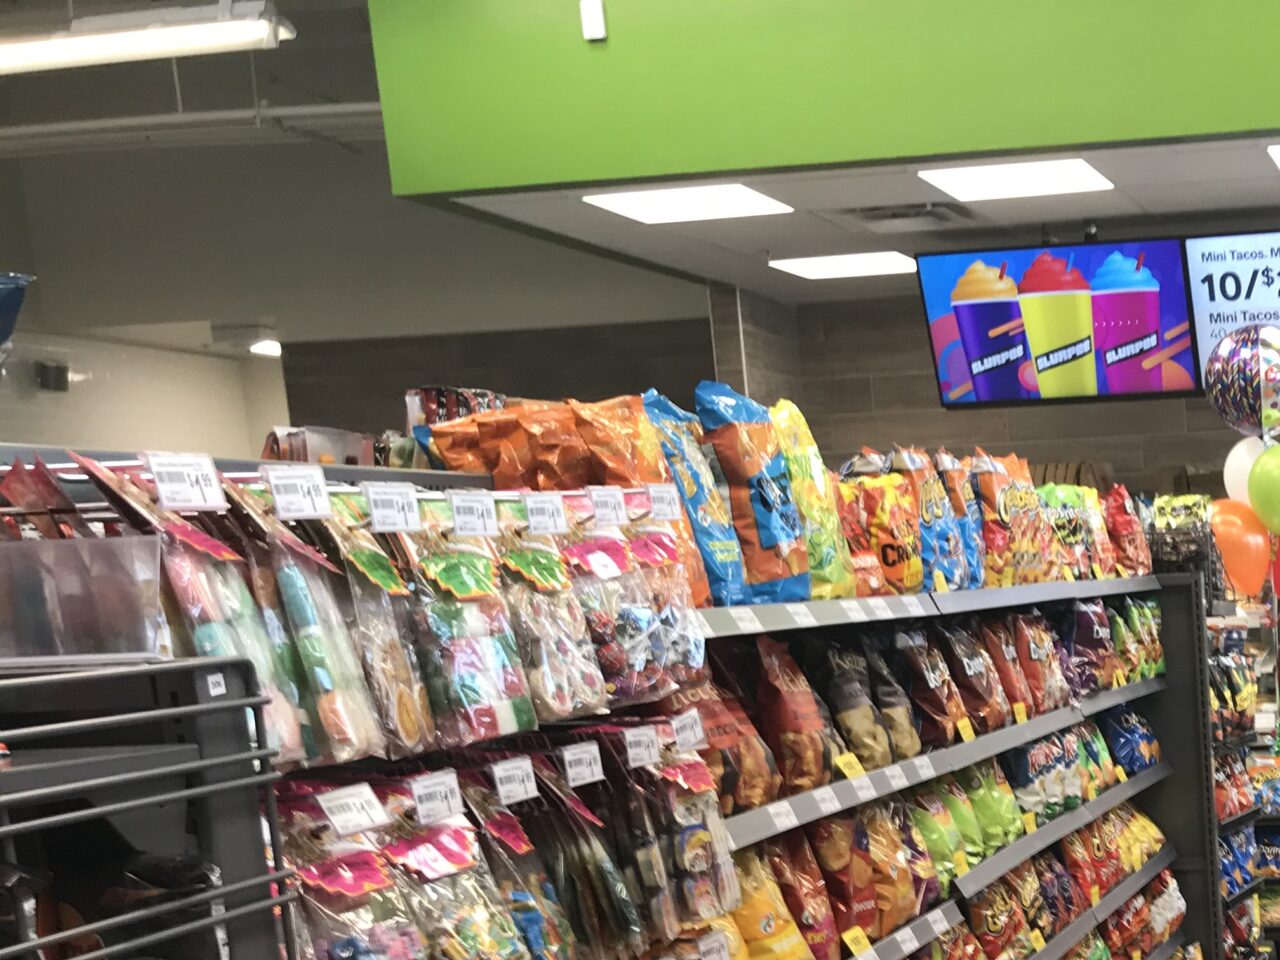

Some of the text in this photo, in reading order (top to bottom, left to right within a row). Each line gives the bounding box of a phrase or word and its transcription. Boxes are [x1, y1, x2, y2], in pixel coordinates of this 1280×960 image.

[1201, 250, 1227, 263] Mini
[1229, 249, 1267, 262] Tacos.
[1209, 309, 1280, 324] Mini Tacos
